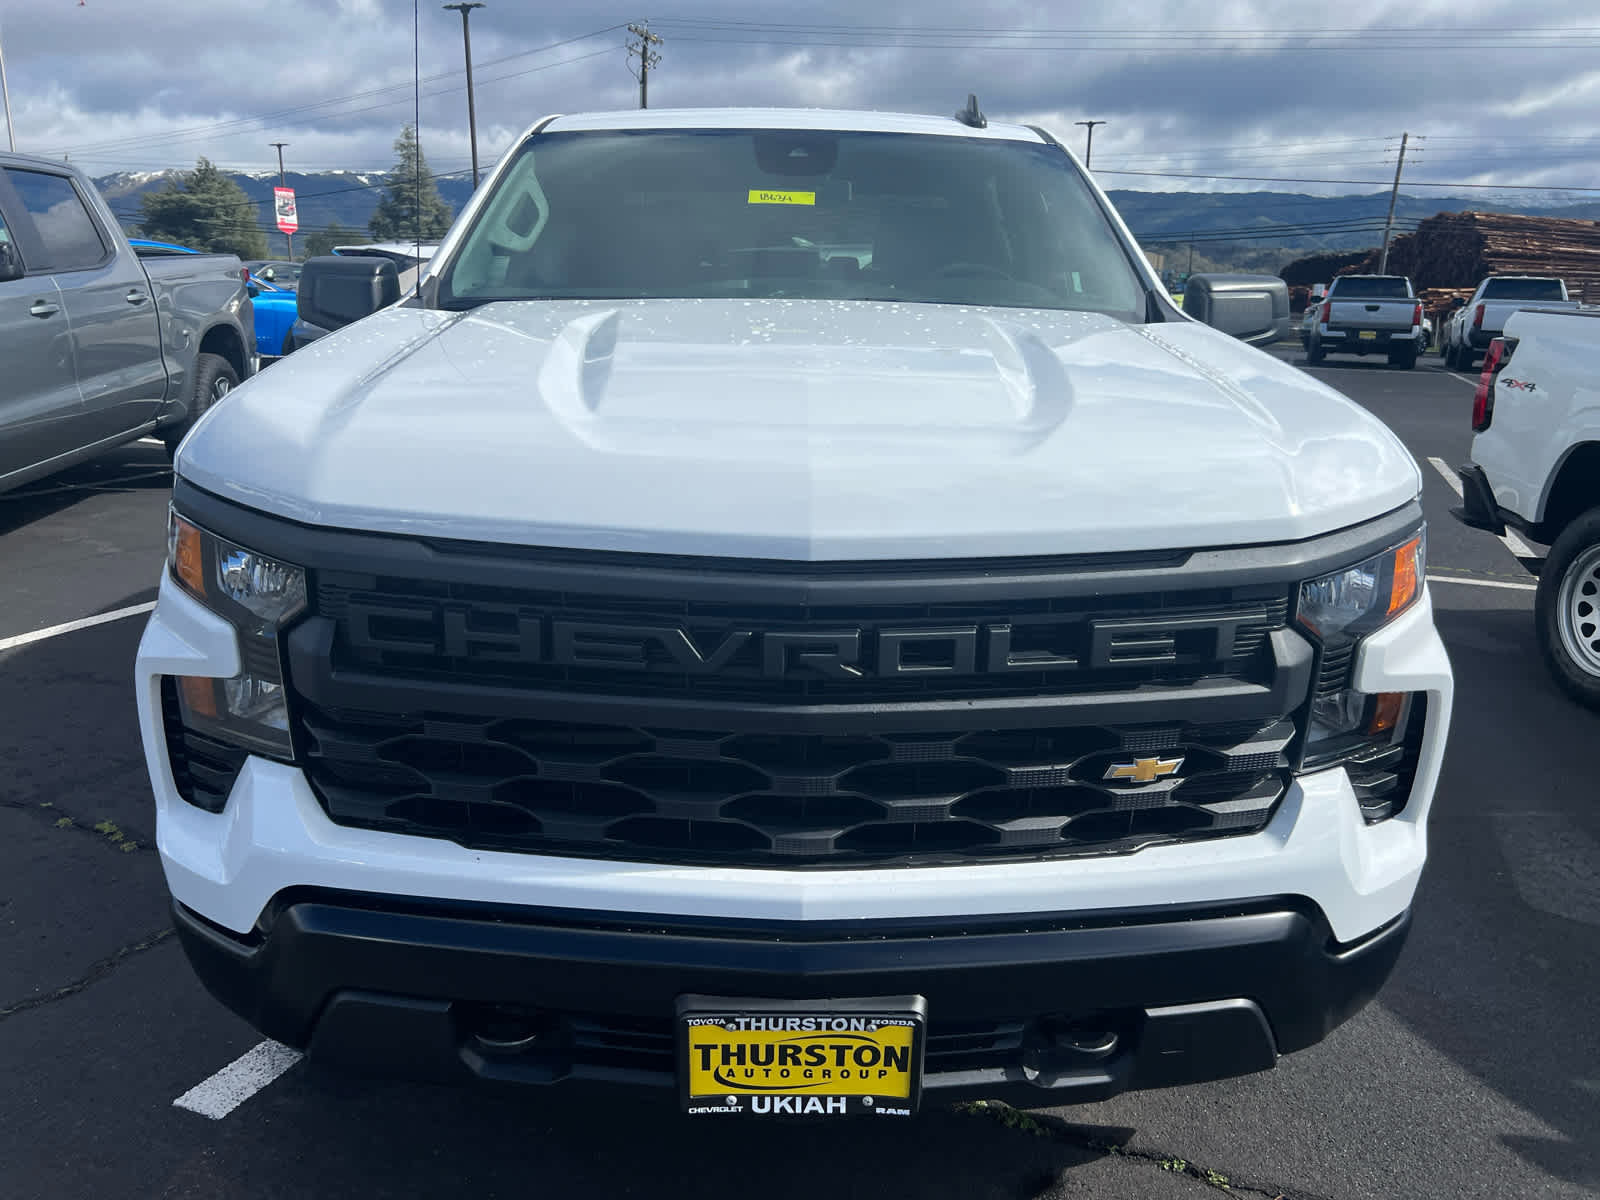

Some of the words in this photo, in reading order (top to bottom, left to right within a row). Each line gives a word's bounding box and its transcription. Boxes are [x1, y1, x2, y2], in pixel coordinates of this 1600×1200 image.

[346, 604, 1269, 680] CHEVROLET
[687, 1018, 726, 1026] TOYOTA
[735, 1017, 866, 1032] THURSTON
[871, 1019, 916, 1027] HONDA
[694, 1044, 910, 1072] THURSTON
[726, 1068, 791, 1078] AUTO
[803, 1069, 888, 1079] GROUP
[688, 1106, 744, 1114] CHEVROLET
[751, 1096, 847, 1114] UKIAH
[875, 1107, 910, 1116] RAM
